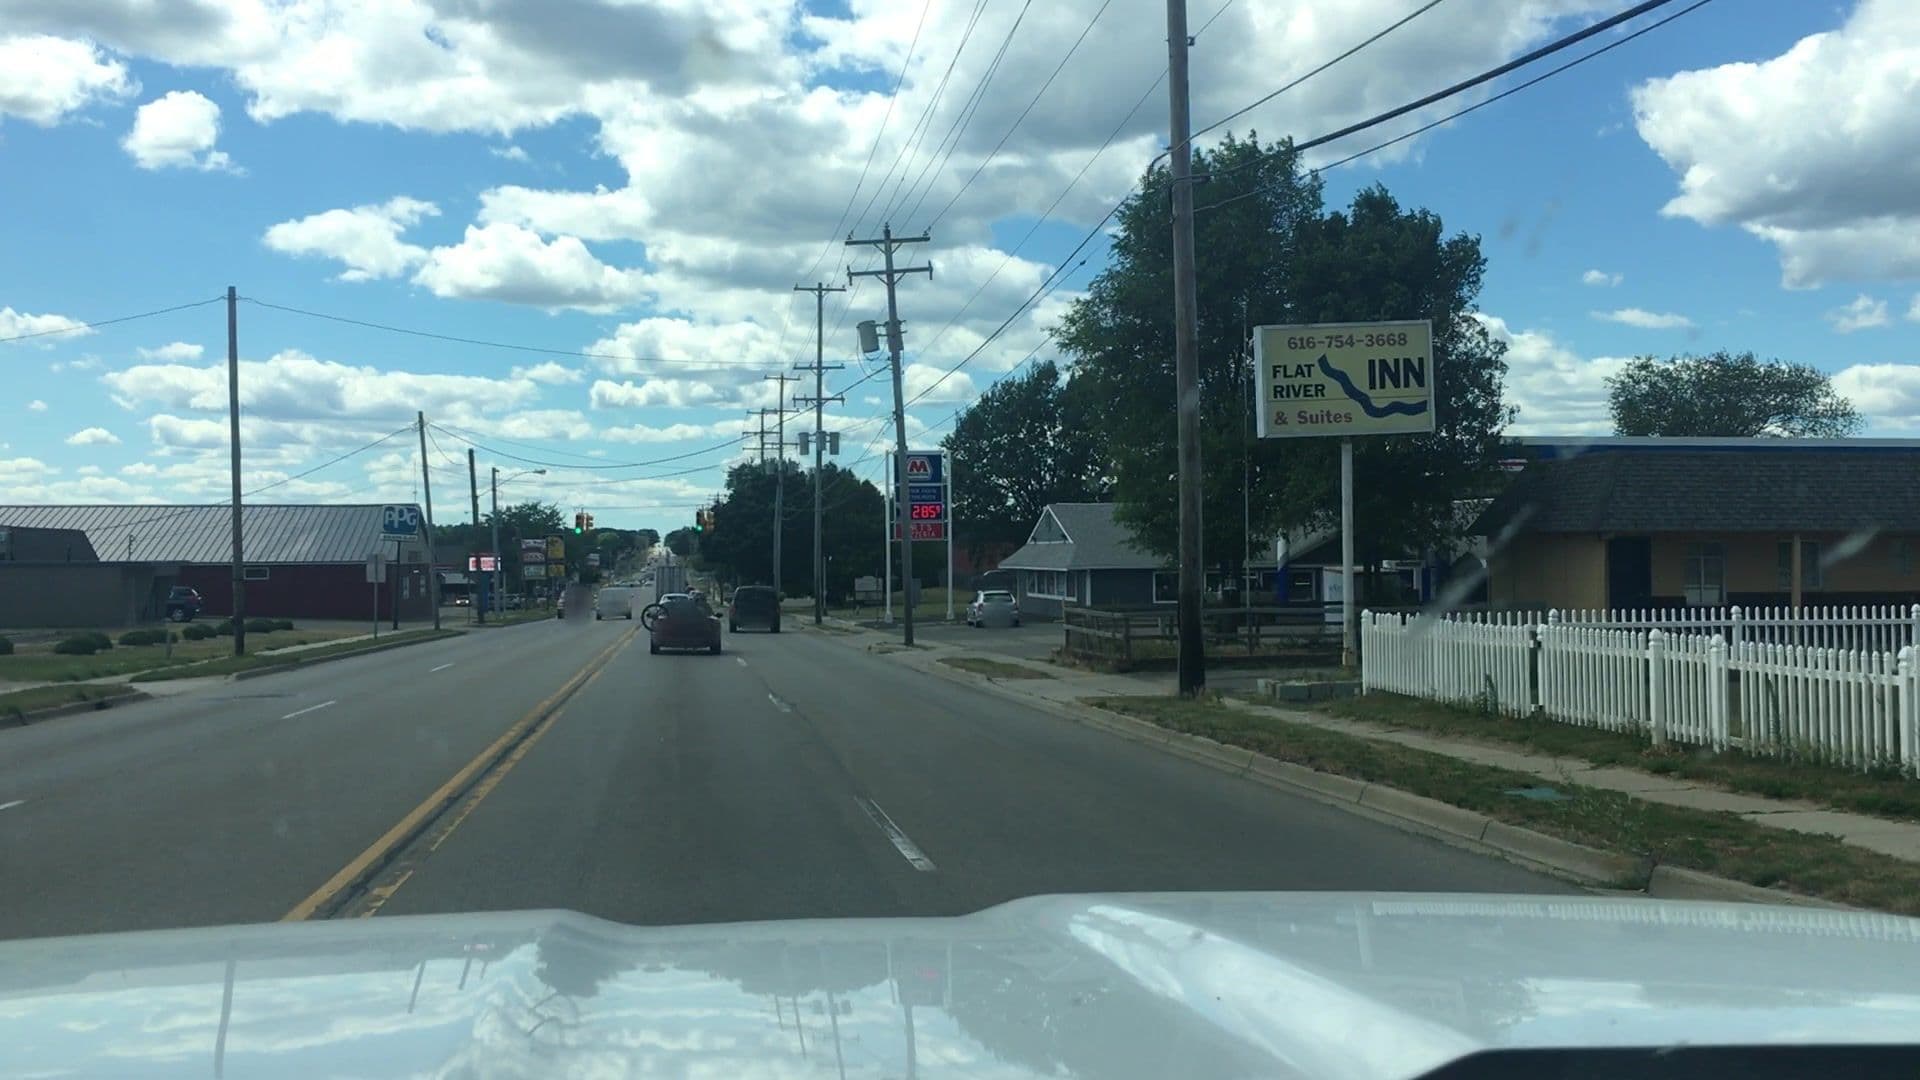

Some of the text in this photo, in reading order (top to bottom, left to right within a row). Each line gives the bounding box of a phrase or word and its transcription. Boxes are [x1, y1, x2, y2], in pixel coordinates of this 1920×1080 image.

[1287, 332, 1408, 351] 616-754-3668
[1272, 364, 1315, 379] FLAT
[1368, 357, 1425, 390] INN
[1273, 383, 1326, 399] RIVER
[1274, 409, 1353, 425] & Suites
[385, 506, 416, 528] PPG
